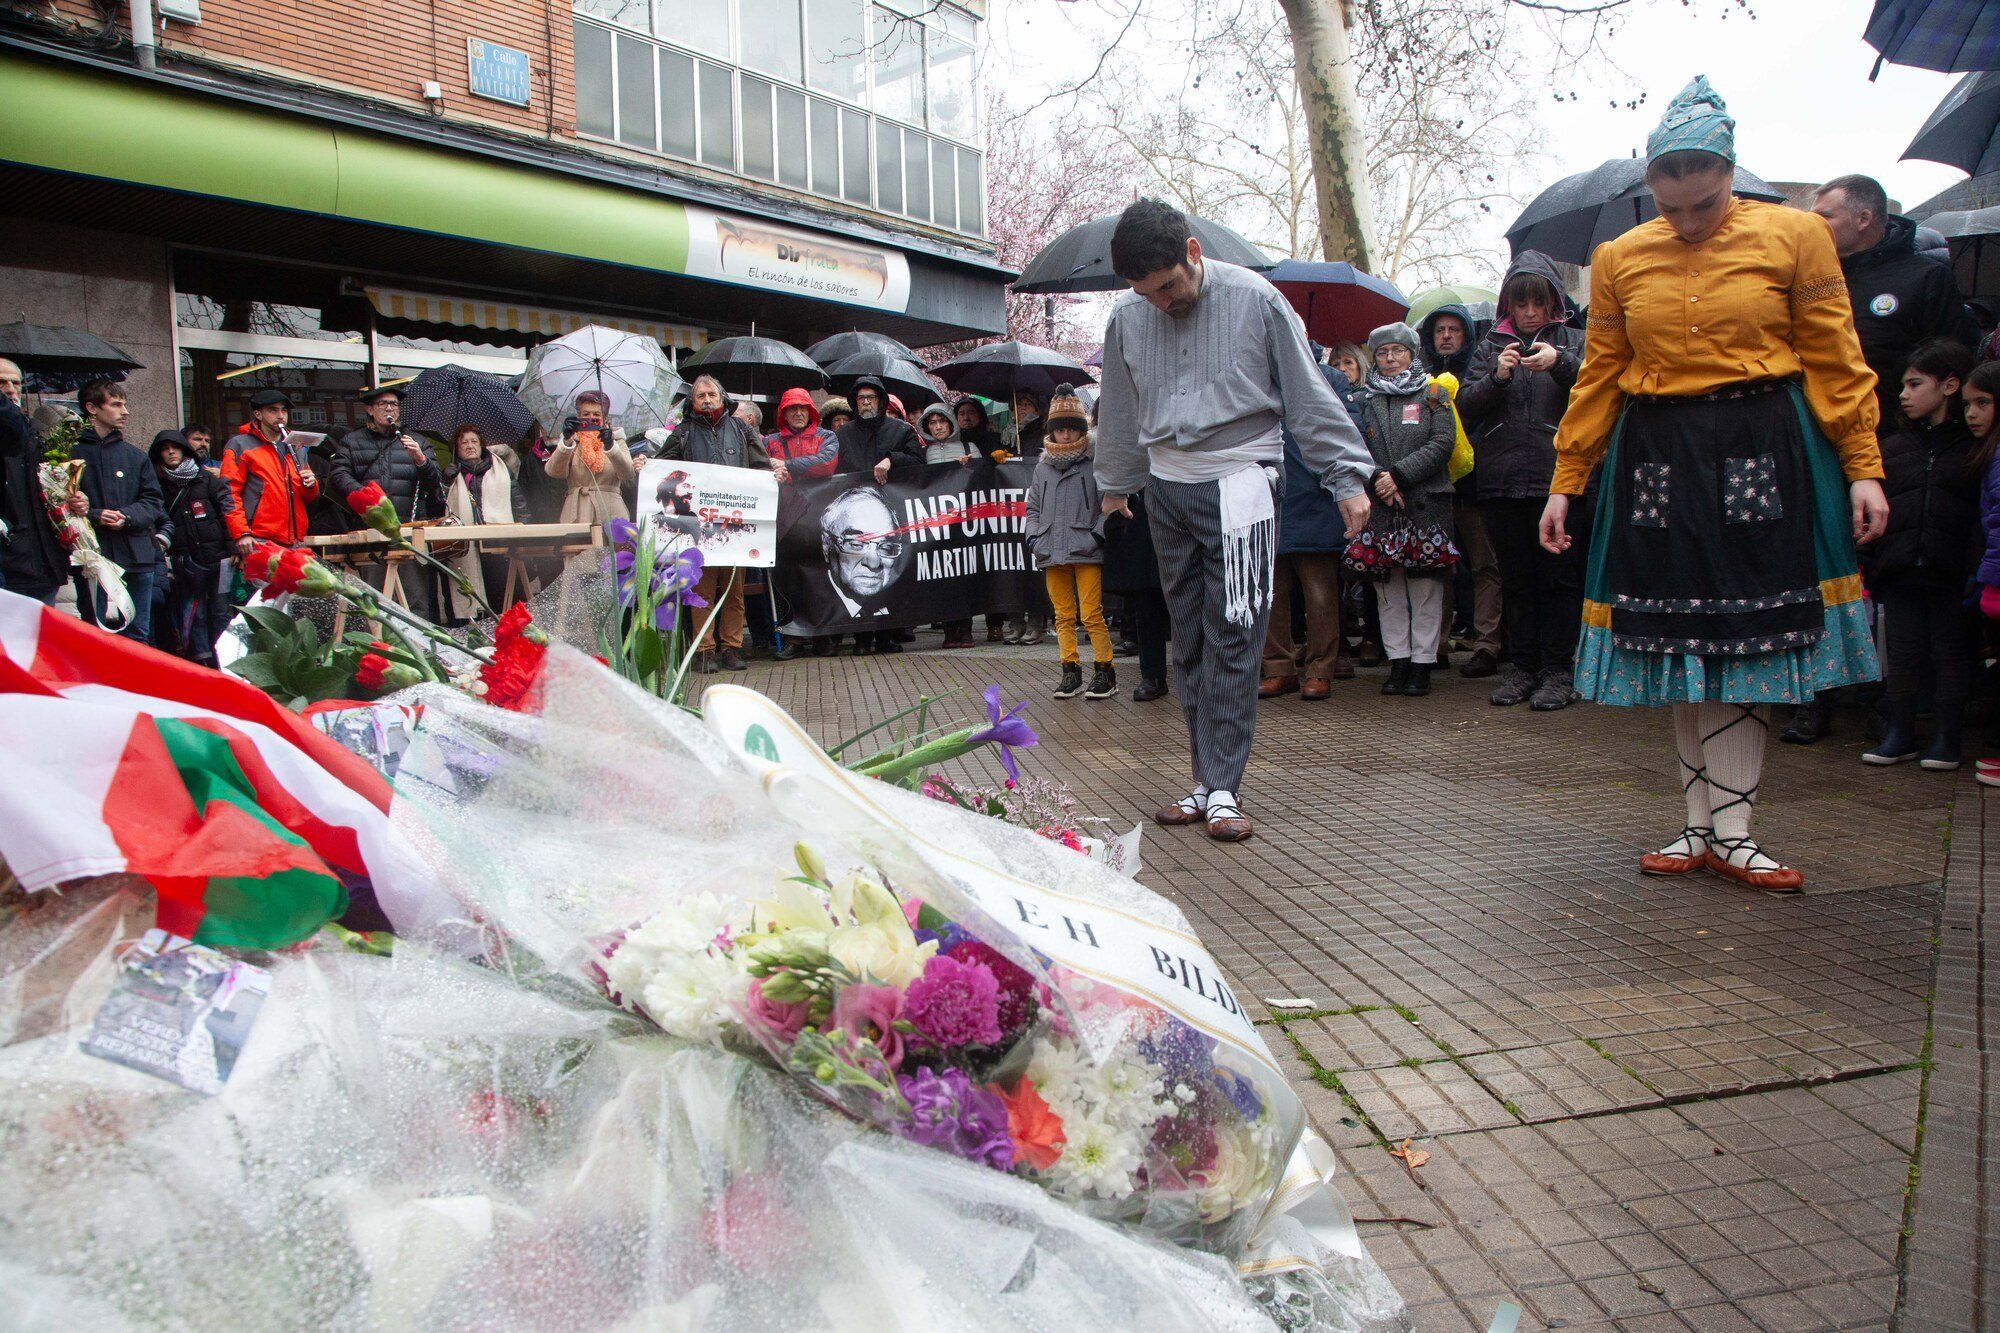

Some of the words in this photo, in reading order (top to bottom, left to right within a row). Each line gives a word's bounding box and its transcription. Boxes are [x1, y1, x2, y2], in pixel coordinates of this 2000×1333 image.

[493, 49, 517, 65] Calle
[748, 267, 759, 278] El
[761, 270, 795, 285] rincón
[797, 277, 808, 288] de
[810, 278, 823, 290] los
[825, 282, 859, 297] sabores
[716, 499, 756, 509] impunidad
[917, 545, 977, 581] MARTIN
[982, 542, 1026, 571] VILLA
[1013, 897, 1049, 930] E
[1062, 915, 1101, 949] H
